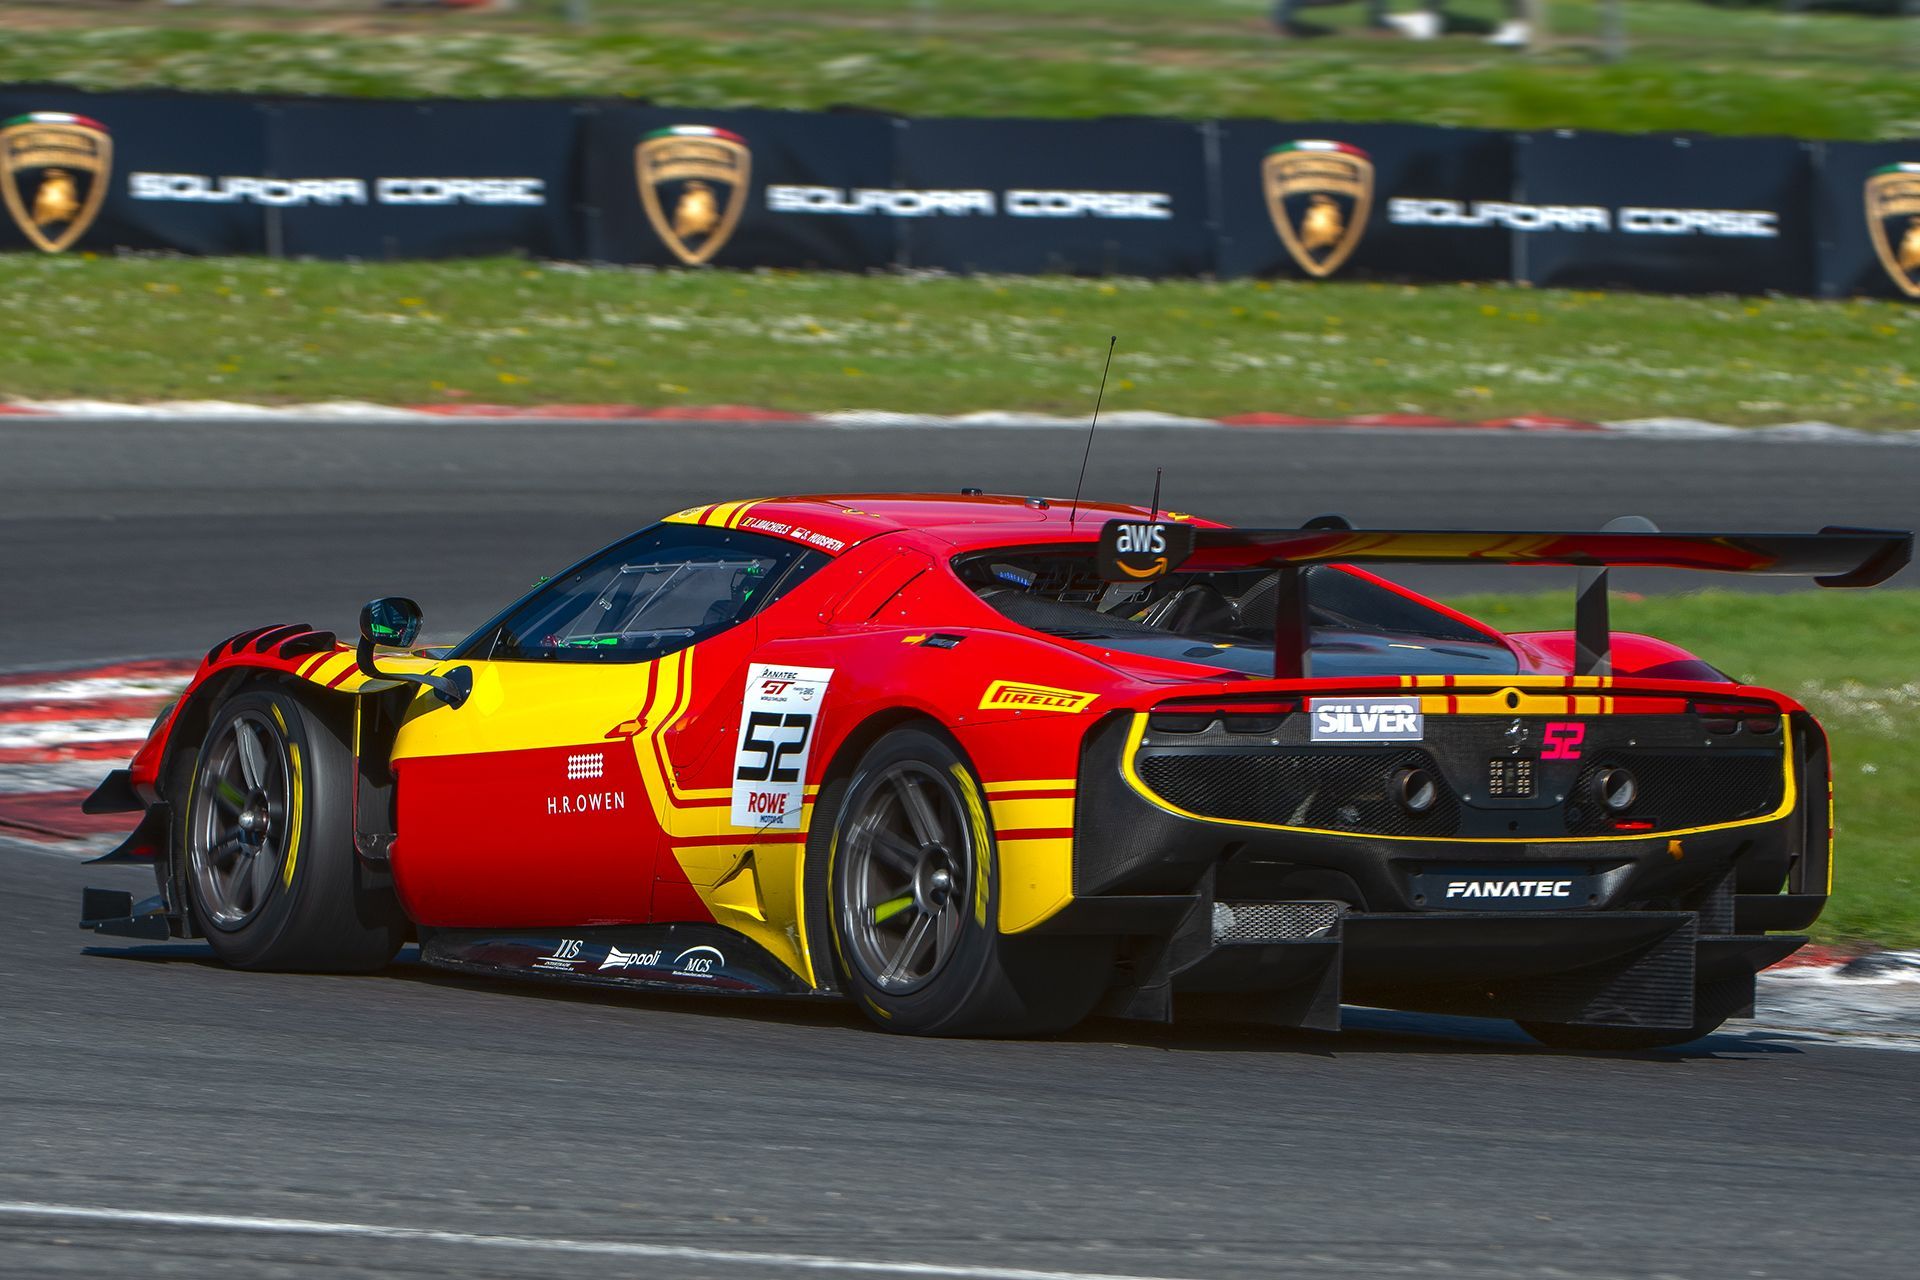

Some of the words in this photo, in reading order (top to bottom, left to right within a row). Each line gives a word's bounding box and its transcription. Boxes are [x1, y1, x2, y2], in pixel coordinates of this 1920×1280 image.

[376, 177, 545, 204] CORSE
[1006, 190, 1172, 218] CORSE
[1619, 207, 1779, 237] CORSE
[1116, 524, 1167, 553] aws
[991, 685, 1085, 708] PIRELLI
[1316, 704, 1418, 734] SILVER
[736, 711, 812, 783] 52
[1540, 721, 1586, 760] 52
[748, 791, 788, 815] ROWE
[1446, 881, 1572, 898] FANATEC
[623, 950, 662, 969] paoli
[684, 957, 713, 973] MCS
